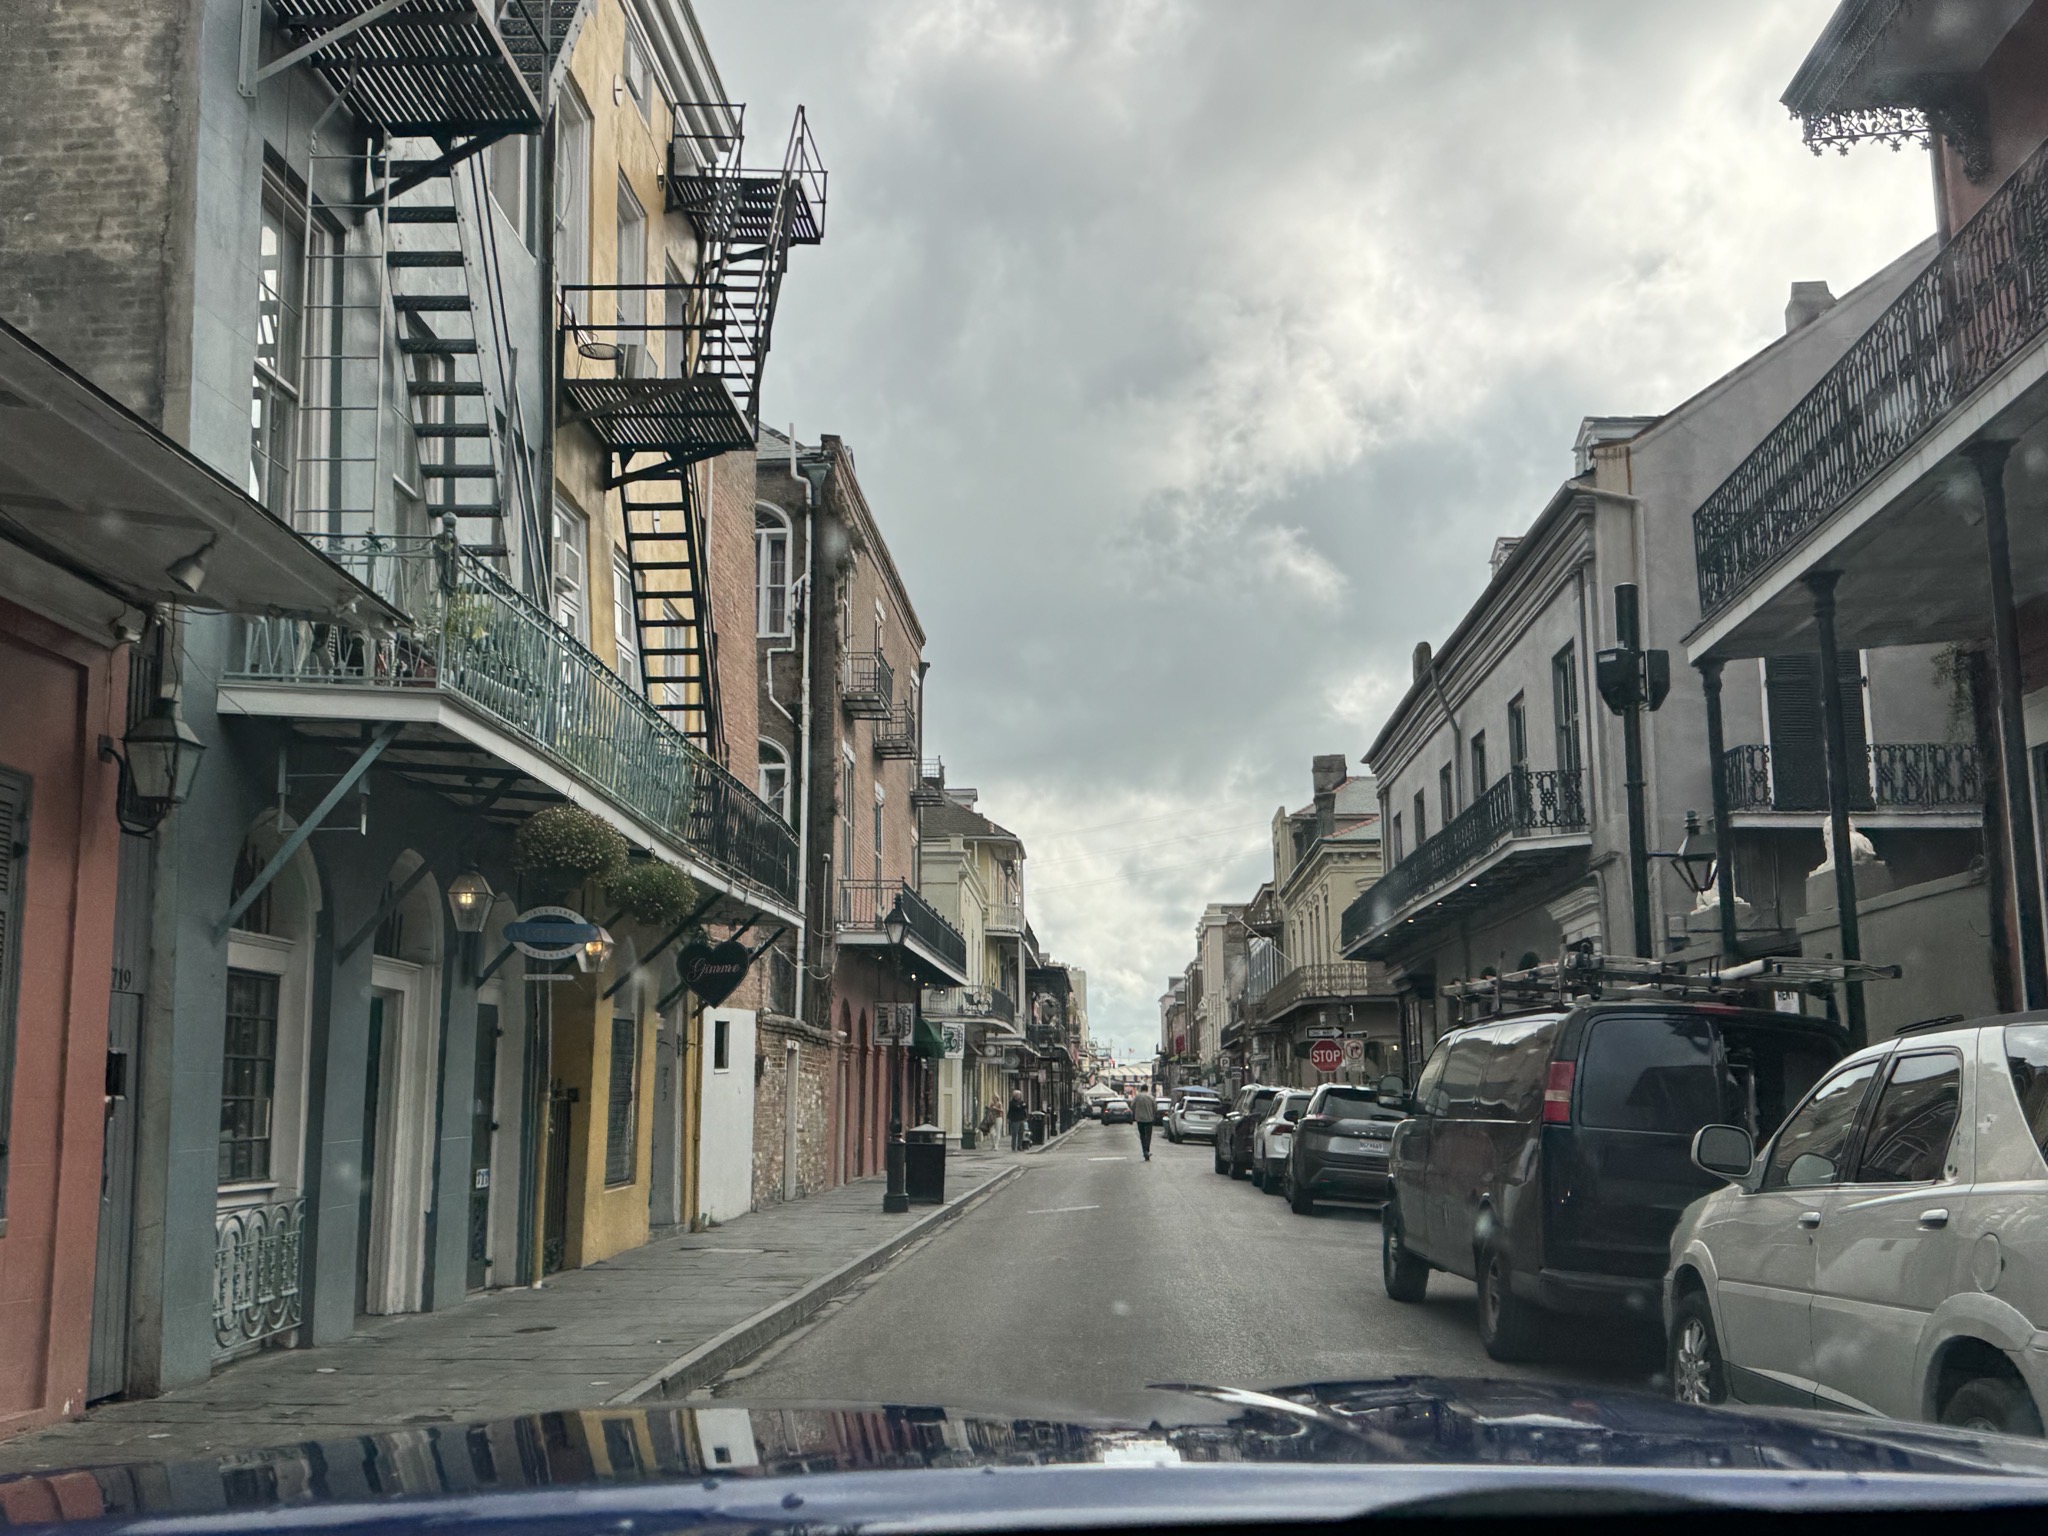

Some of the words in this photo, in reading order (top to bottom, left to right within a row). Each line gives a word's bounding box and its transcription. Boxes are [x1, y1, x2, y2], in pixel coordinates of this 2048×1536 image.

[111, 967, 131, 990] 719
[686, 957, 741, 982] Gimme
[1312, 1049, 1341, 1063] STOP
